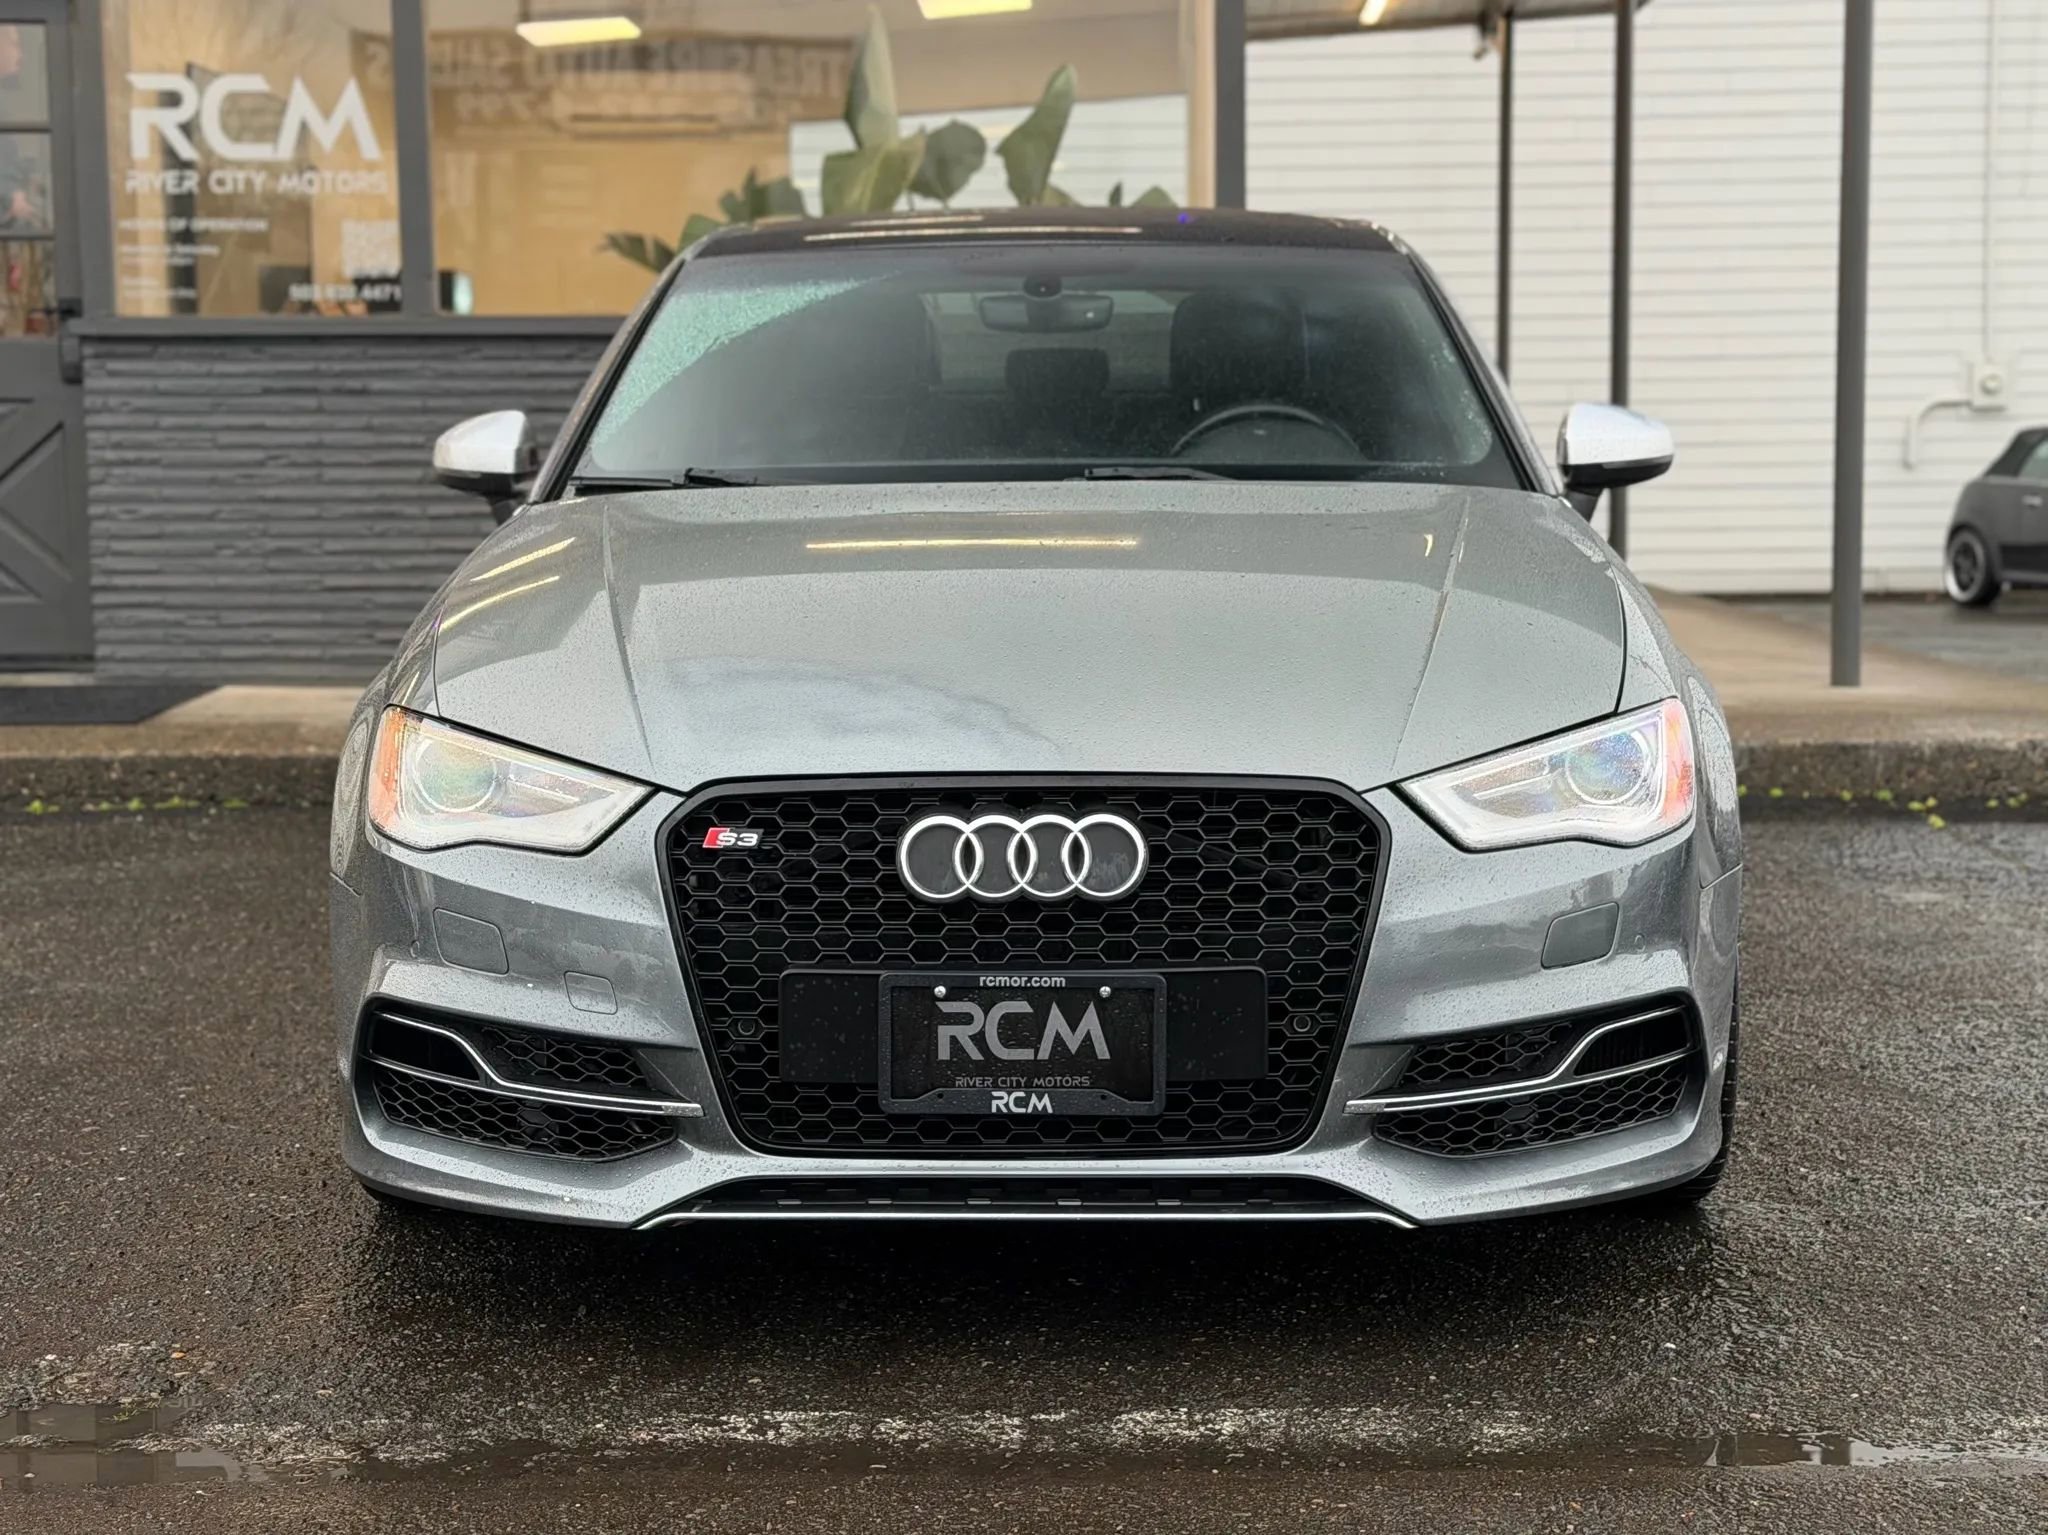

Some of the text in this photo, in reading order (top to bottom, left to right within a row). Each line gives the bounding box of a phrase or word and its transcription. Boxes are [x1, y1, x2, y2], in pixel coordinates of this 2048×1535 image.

[125, 73, 382, 161] RCM
[125, 169, 388, 195] RIVER CITY MOTORS
[715, 832, 758, 847] S3
[979, 976, 1066, 988] rcmor.com
[935, 1000, 1111, 1060] RCM
[955, 1075, 1090, 1088] RIVER CITY MOTORS
[991, 1091, 1054, 1113] RCM
